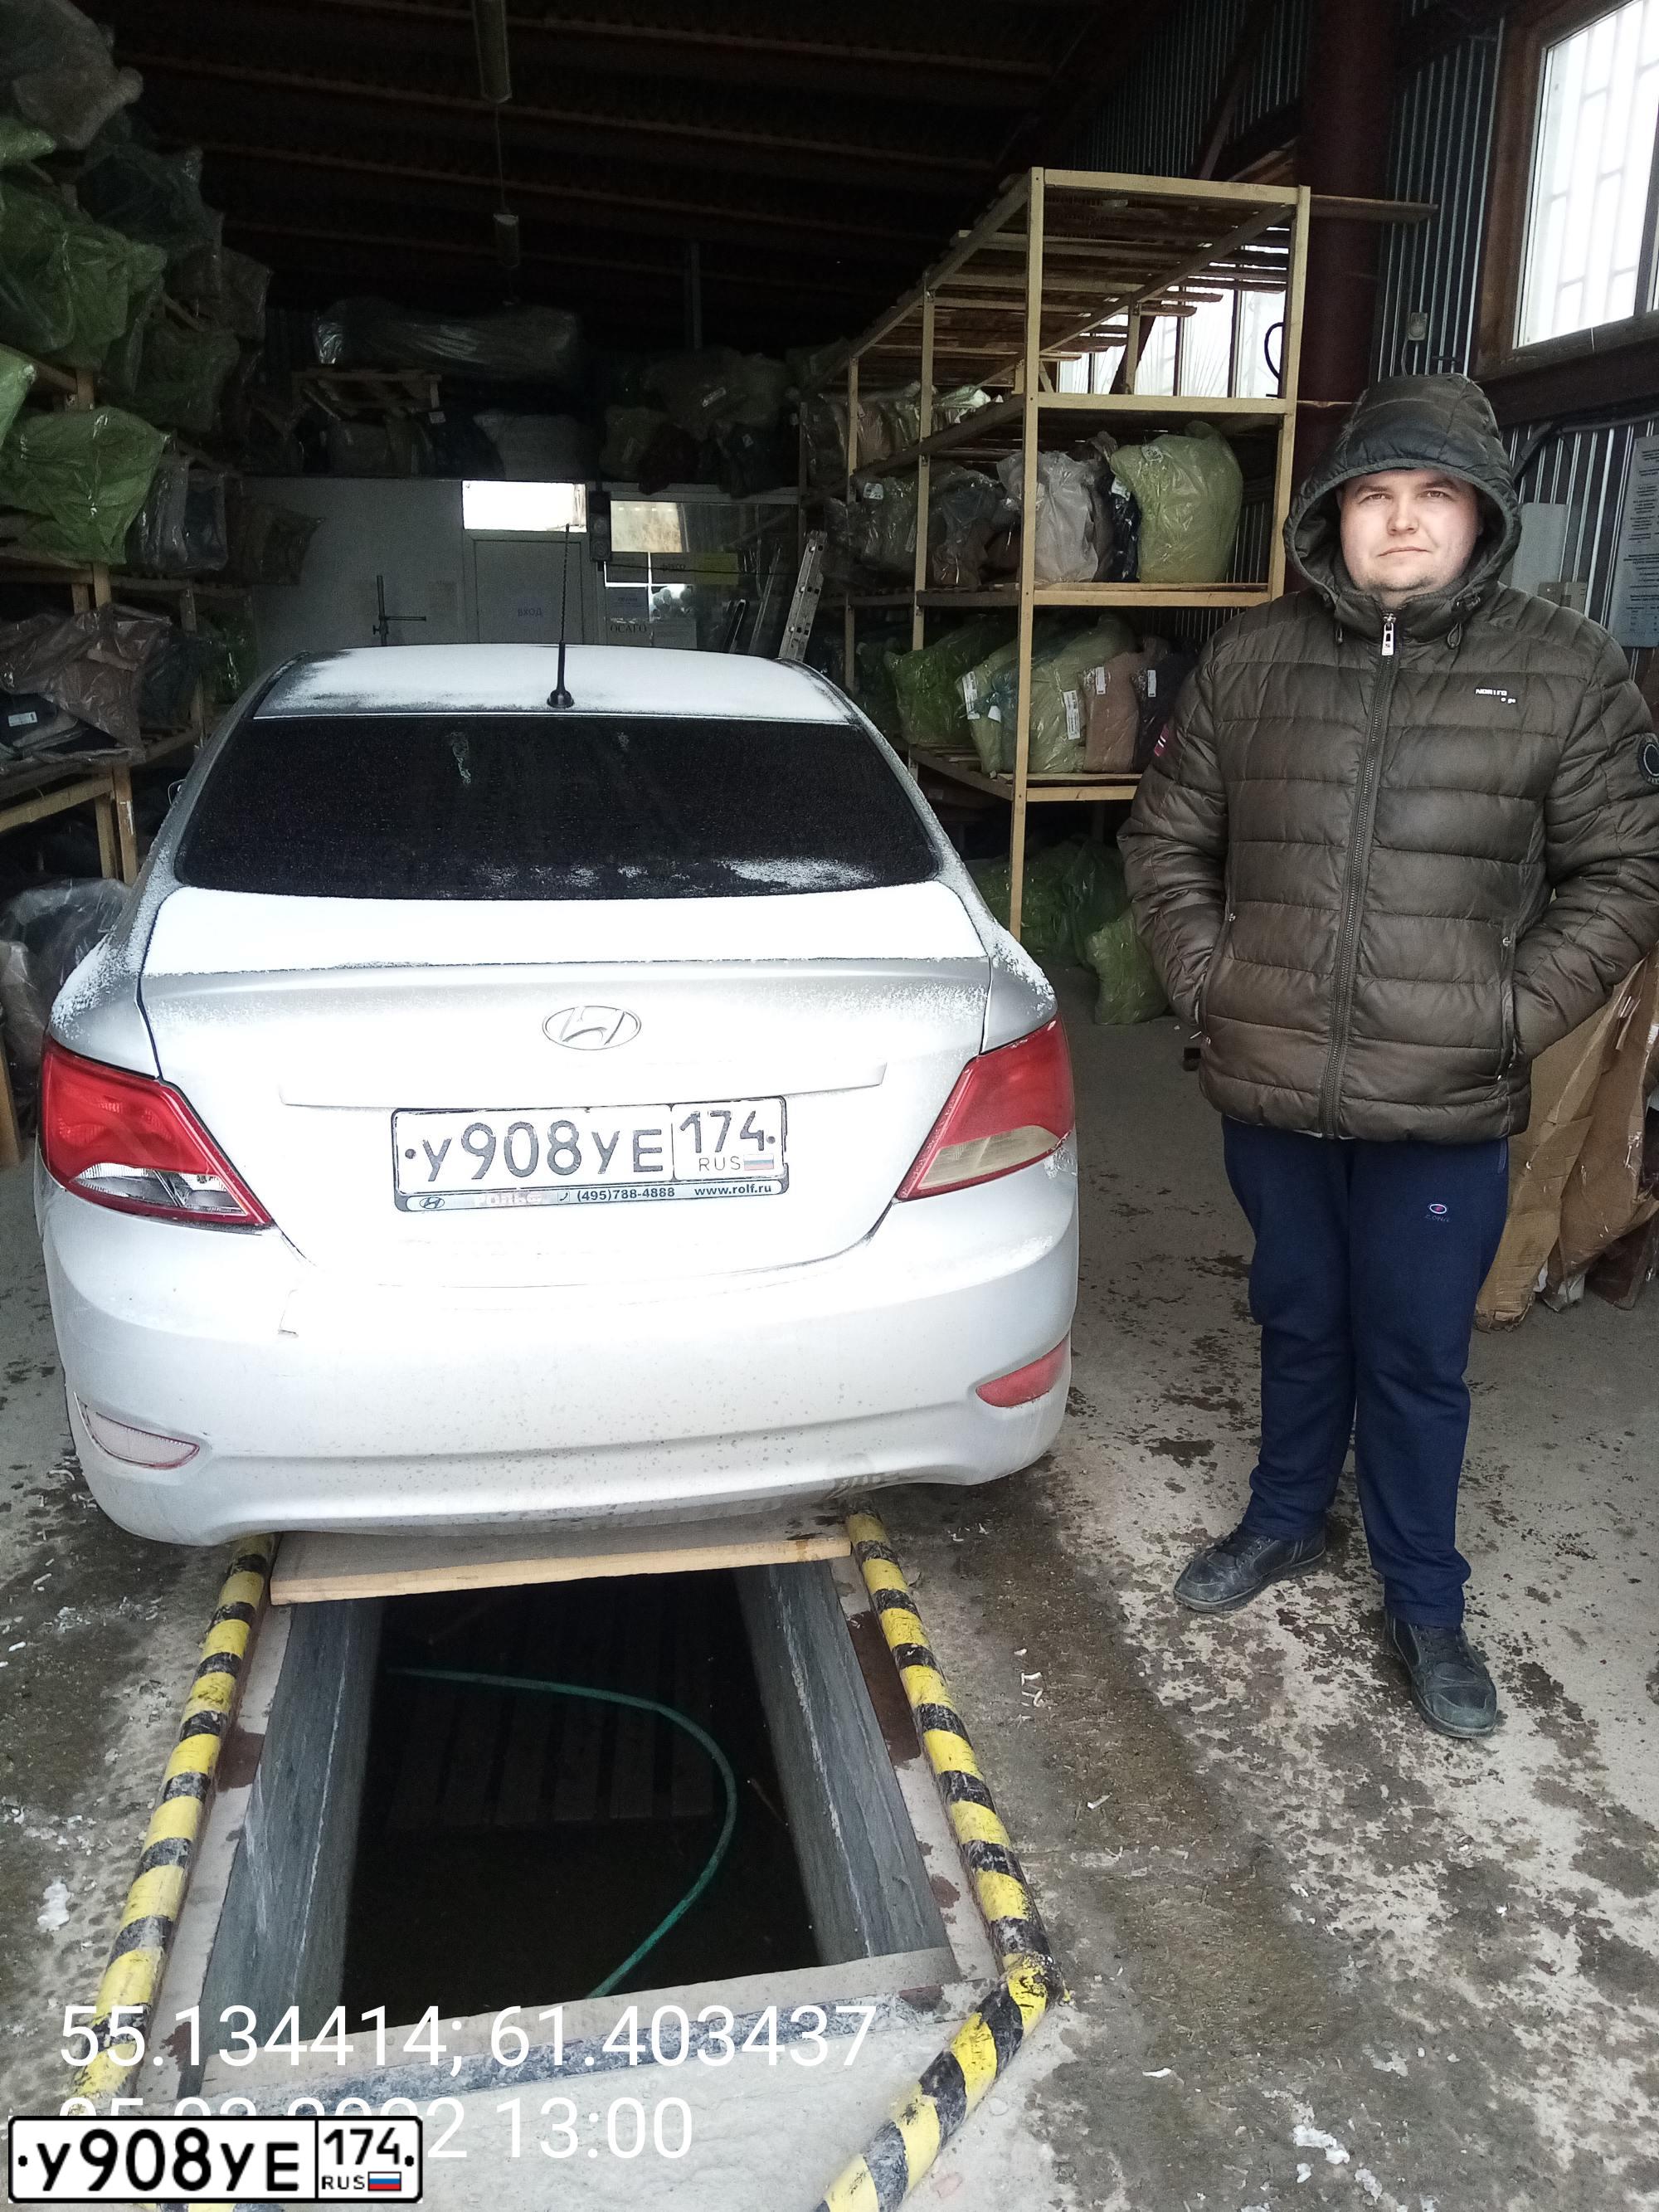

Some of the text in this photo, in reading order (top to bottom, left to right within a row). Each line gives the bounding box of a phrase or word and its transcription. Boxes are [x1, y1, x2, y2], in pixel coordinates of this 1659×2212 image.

[610, 623, 647, 633] ОСАГО
[679, 1109, 766, 1153] 174
[698, 1156, 741, 1172] RUS
[577, 1183, 772, 1202] (495)788-4888 www.rolf.ru
